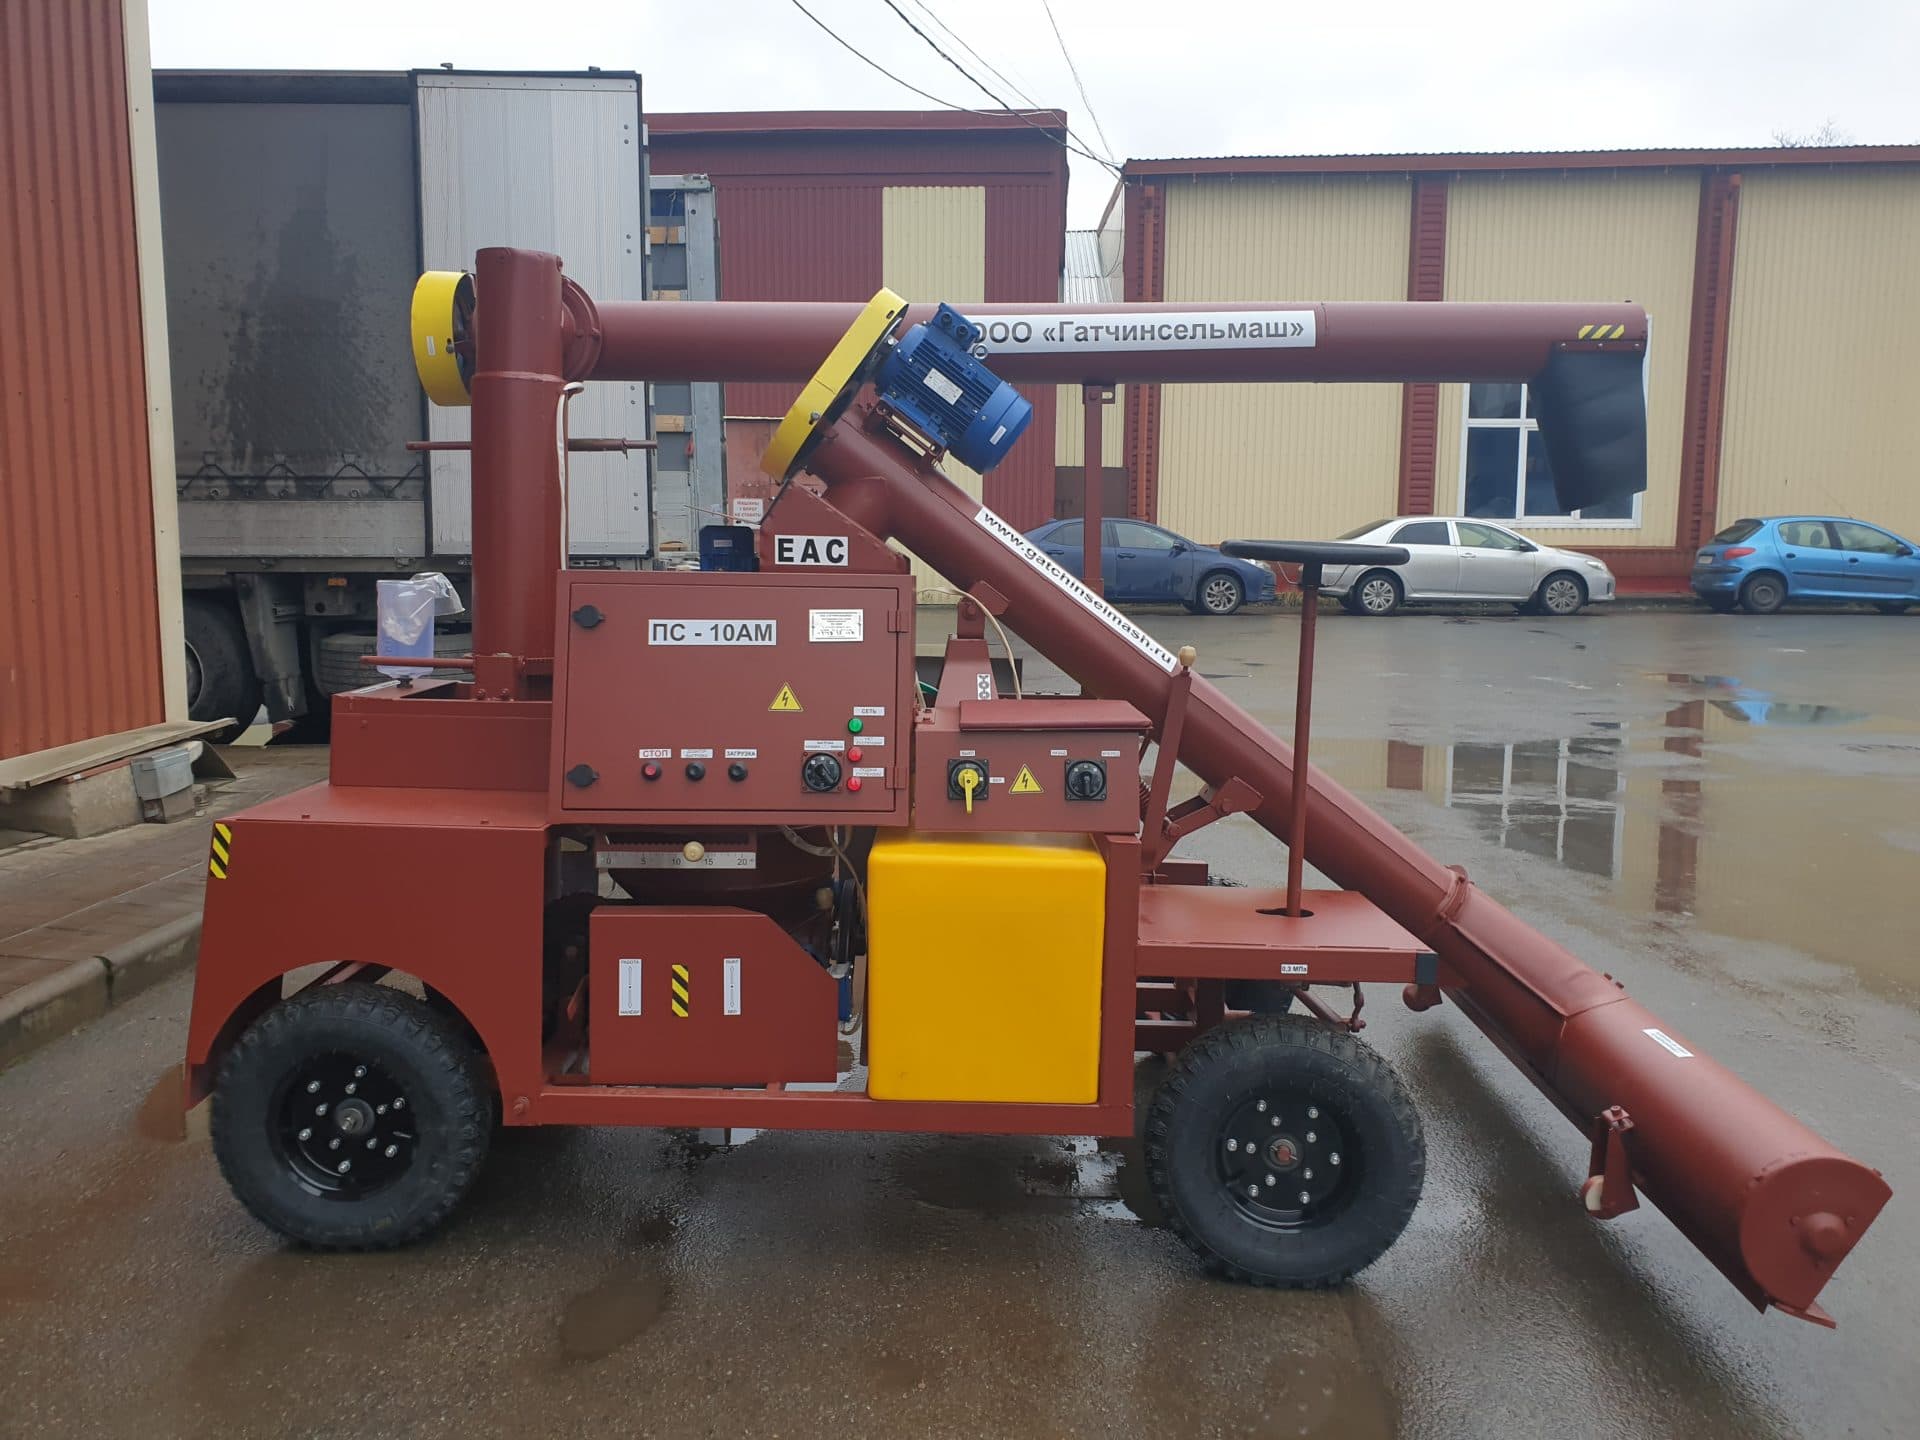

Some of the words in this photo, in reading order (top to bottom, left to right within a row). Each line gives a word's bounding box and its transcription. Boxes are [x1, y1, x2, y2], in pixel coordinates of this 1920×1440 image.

[1042, 321, 1305, 343] «Гатчинсельмаш»
[777, 538, 845, 564] EAC
[985, 513, 1172, 665] www.gatchinselmash.ru
[653, 623, 686, 642] ПС
[710, 623, 773, 642] 10АМ
[642, 750, 669, 758] СТОП
[671, 858, 682, 866] 10
[704, 858, 714, 866] 15
[737, 858, 748, 866] 20
